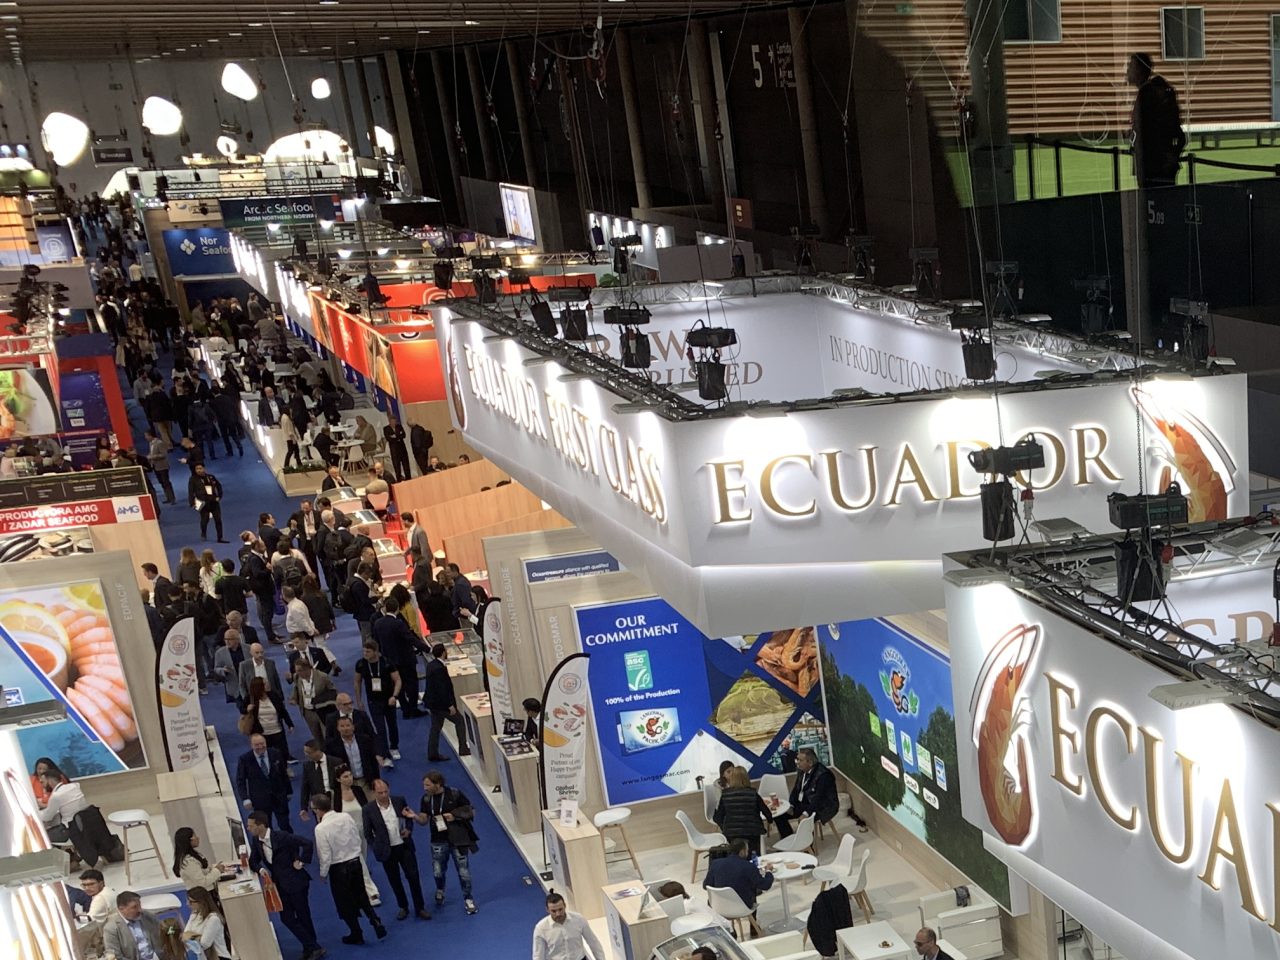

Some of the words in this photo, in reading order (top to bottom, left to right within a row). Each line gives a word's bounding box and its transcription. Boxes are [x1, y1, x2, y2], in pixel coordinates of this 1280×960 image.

[751, 44, 763, 88] 5
[244, 204, 272, 215] Arcc
[200, 236, 217, 246] Nor
[829, 335, 843, 362] IN
[845, 340, 931, 391] PRODUCTION
[464, 343, 548, 441] ECUADOR
[544, 388, 599, 477] FIRST
[600, 423, 668, 525] CLASS
[706, 422, 1124, 526] ECUADOR
[75, 504, 98, 514] AMG
[117, 504, 140, 515] AMG
[9, 518, 45, 531] ZADAR
[47, 514, 98, 526] SEAFOOD
[615, 614, 646, 629] OUR
[585, 622, 679, 647] COMMITMENT
[605, 696, 624, 705] 100%
[625, 694, 633, 703] of
[634, 692, 645, 700] the
[645, 688, 681, 699] Production
[555, 784, 575, 792] Global
[559, 788, 579, 796] Shrimp
